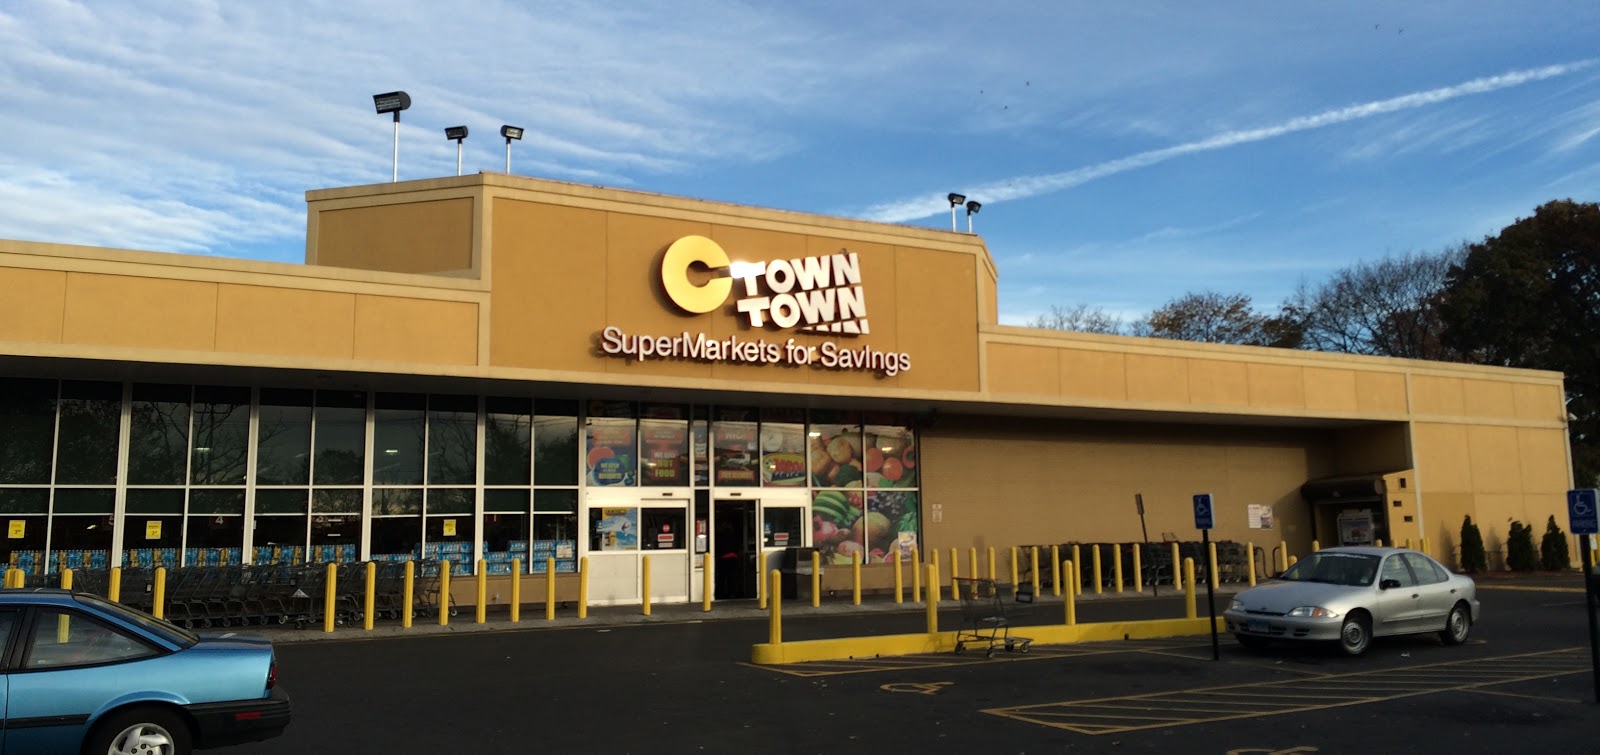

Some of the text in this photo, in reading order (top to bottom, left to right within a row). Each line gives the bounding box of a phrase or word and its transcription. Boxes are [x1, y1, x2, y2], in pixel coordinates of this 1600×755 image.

[661, 235, 861, 313] C TOWN
[737, 286, 866, 328] TOWN
[602, 325, 780, 362] SuperMarkets
[785, 338, 817, 364] for
